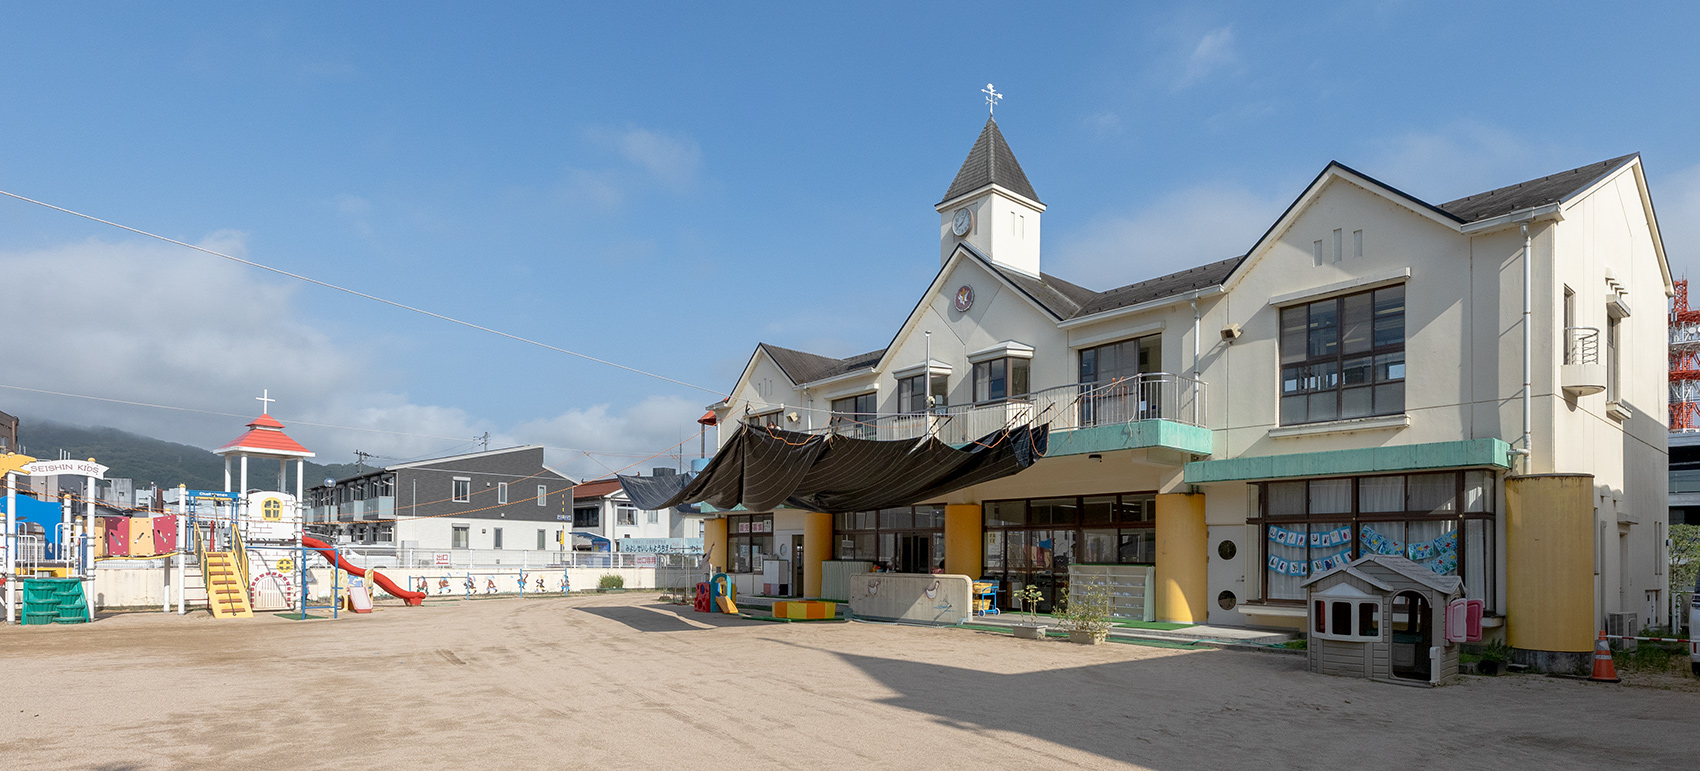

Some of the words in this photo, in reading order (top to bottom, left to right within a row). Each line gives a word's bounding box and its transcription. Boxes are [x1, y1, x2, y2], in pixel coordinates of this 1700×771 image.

[30, 463, 73, 473] SEISHIN
[77, 464, 99, 474] KIDS
[436, 553, 448, 561] 出口
